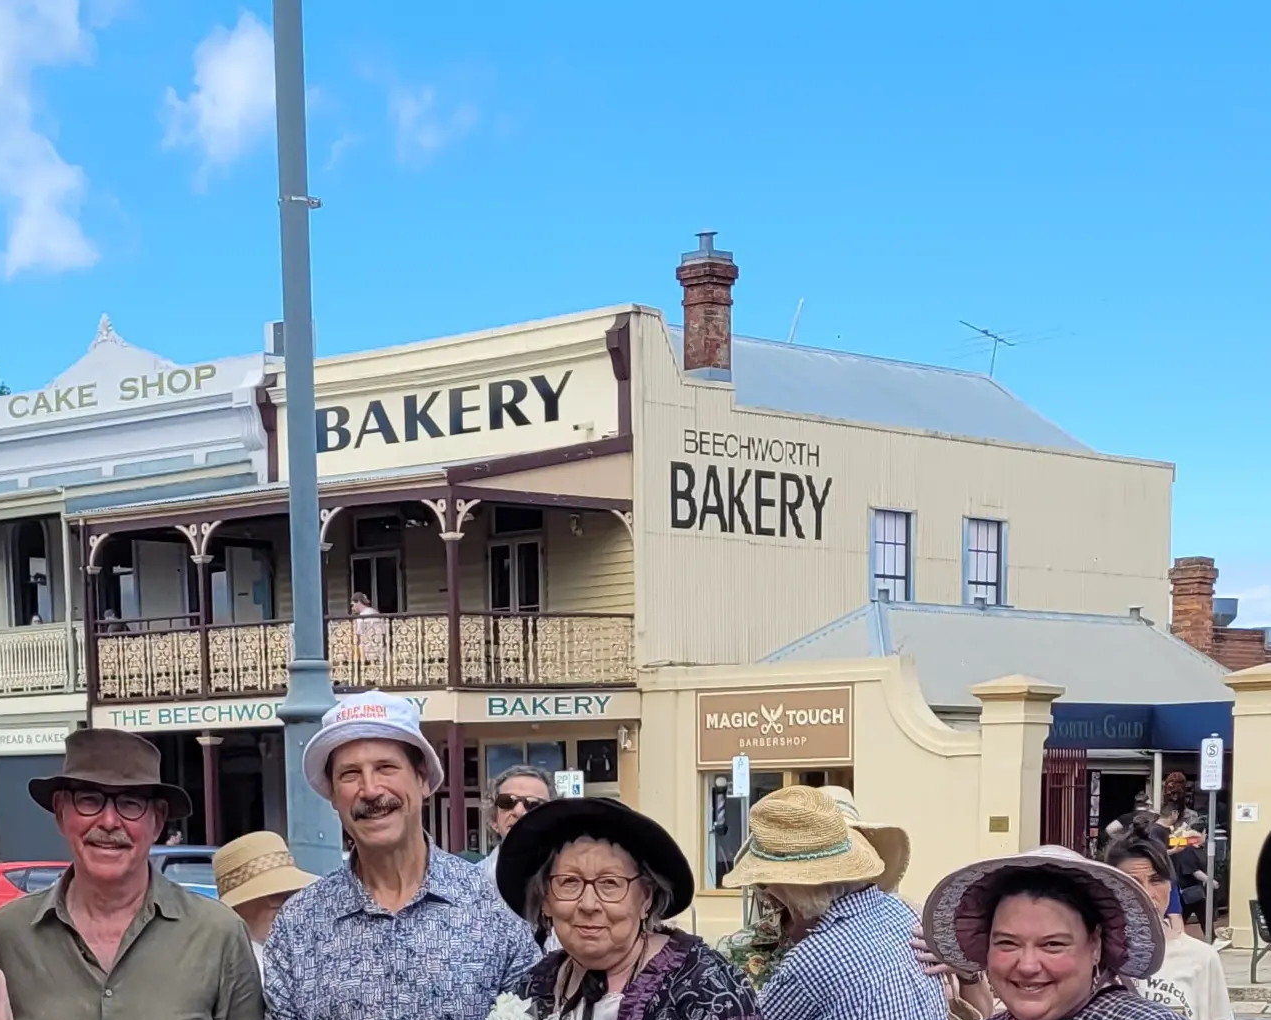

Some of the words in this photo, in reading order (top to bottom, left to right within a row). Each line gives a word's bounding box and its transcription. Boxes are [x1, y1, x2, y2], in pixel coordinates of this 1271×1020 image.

[8, 383, 98, 419] CAKE
[119, 364, 217, 401] SHOP
[315, 370, 573, 453] BAKERY
[684, 429, 820, 467] BEECHWORTH
[670, 460, 832, 540] BAKERY
[108, 709, 153, 727] THE
[158, 702, 284, 726] BEECHWO
[488, 695, 611, 716] BAKERY
[706, 711, 759, 729] MAGIC
[785, 708, 845, 726] TOUCH
[1103, 713, 1144, 739] GOLD
[35, 733, 66, 743] CAKES
[739, 736, 808, 748] BARBERSHOP
[557, 775, 569, 785] 2P
